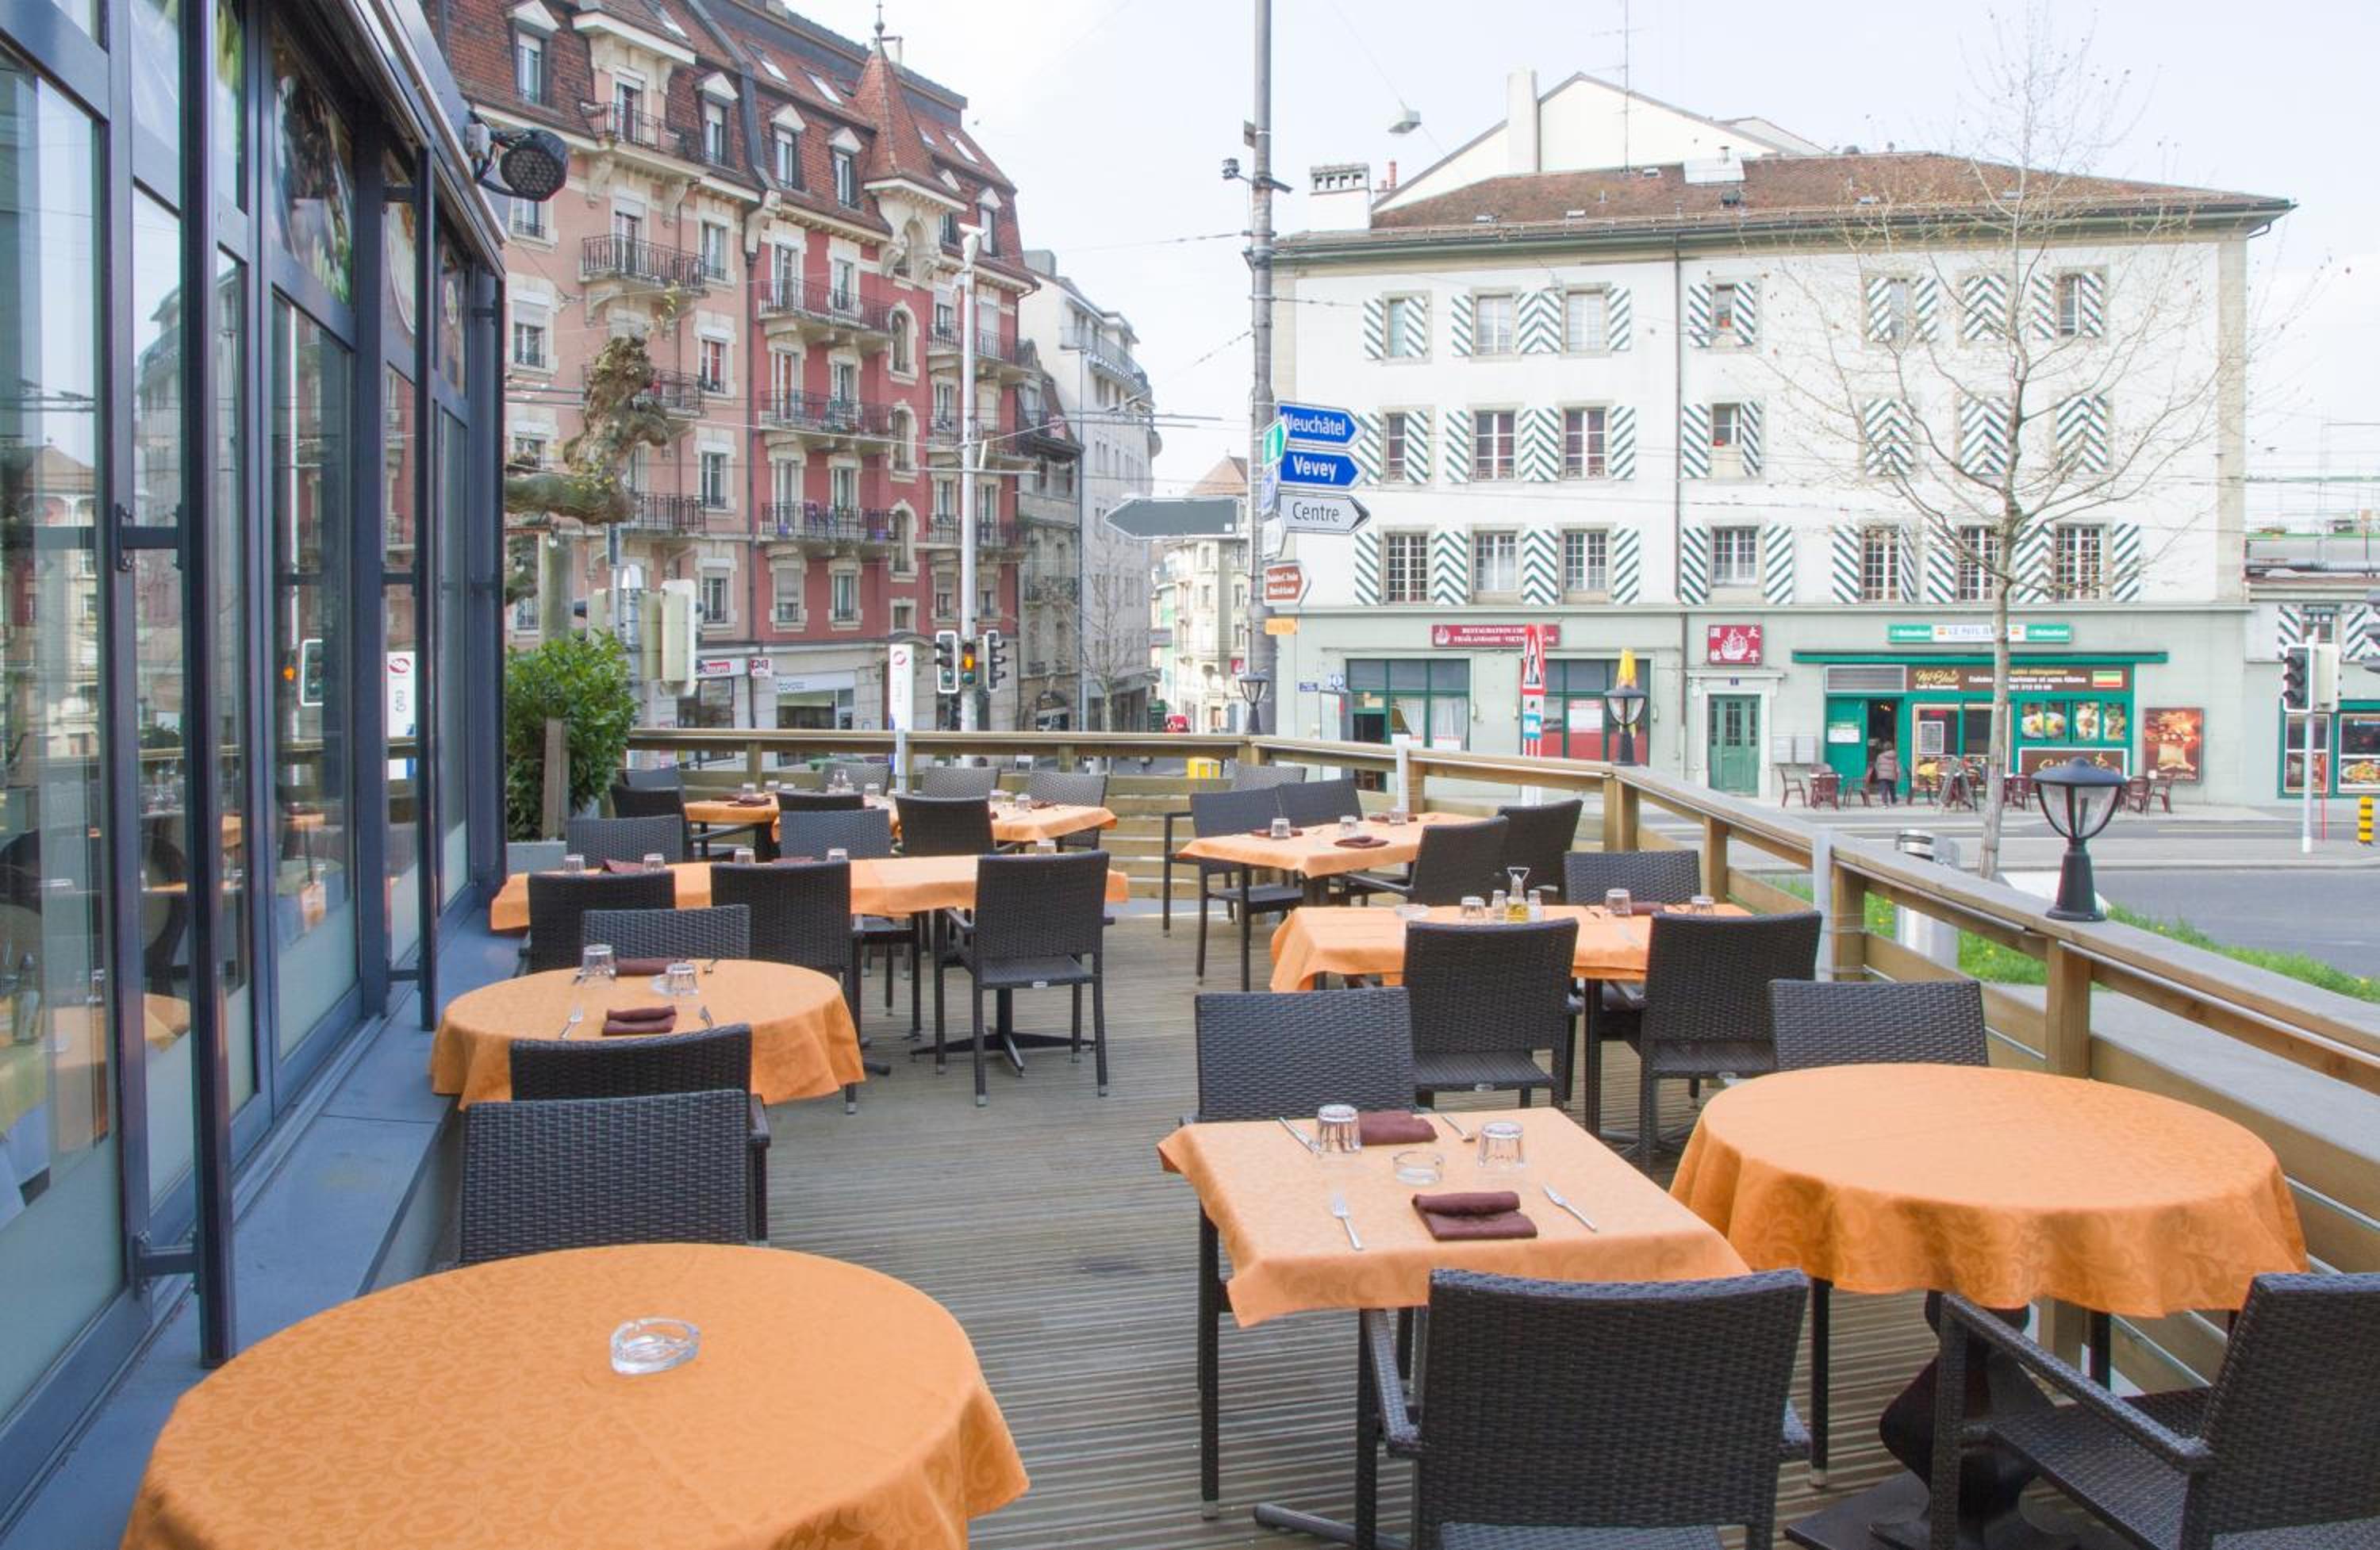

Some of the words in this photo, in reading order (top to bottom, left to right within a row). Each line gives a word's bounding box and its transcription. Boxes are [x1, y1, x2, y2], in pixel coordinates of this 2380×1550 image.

[1284, 413, 1346, 436] Neuchâtel
[1292, 455, 1337, 482] Vevey
[1292, 502, 1340, 522] Centre
